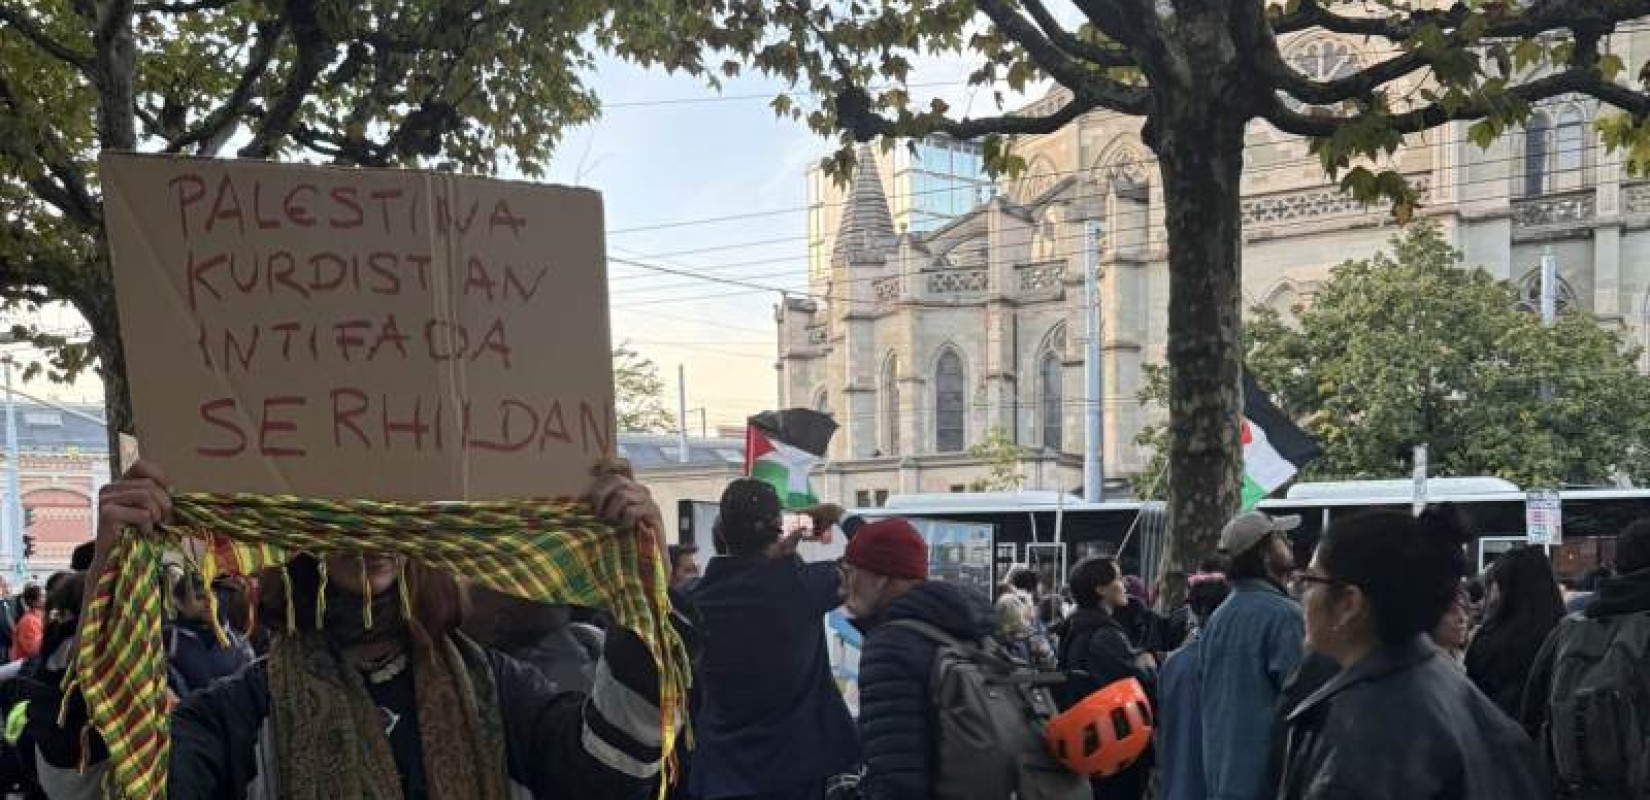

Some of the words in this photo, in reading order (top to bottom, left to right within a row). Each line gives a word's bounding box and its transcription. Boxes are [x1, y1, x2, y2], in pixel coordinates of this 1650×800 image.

[168, 174, 527, 236] PALESTINA
[186, 252, 549, 310] KURDISTAN
[199, 318, 511, 370] INTIFADA
[198, 387, 612, 457] SERHILDAN
